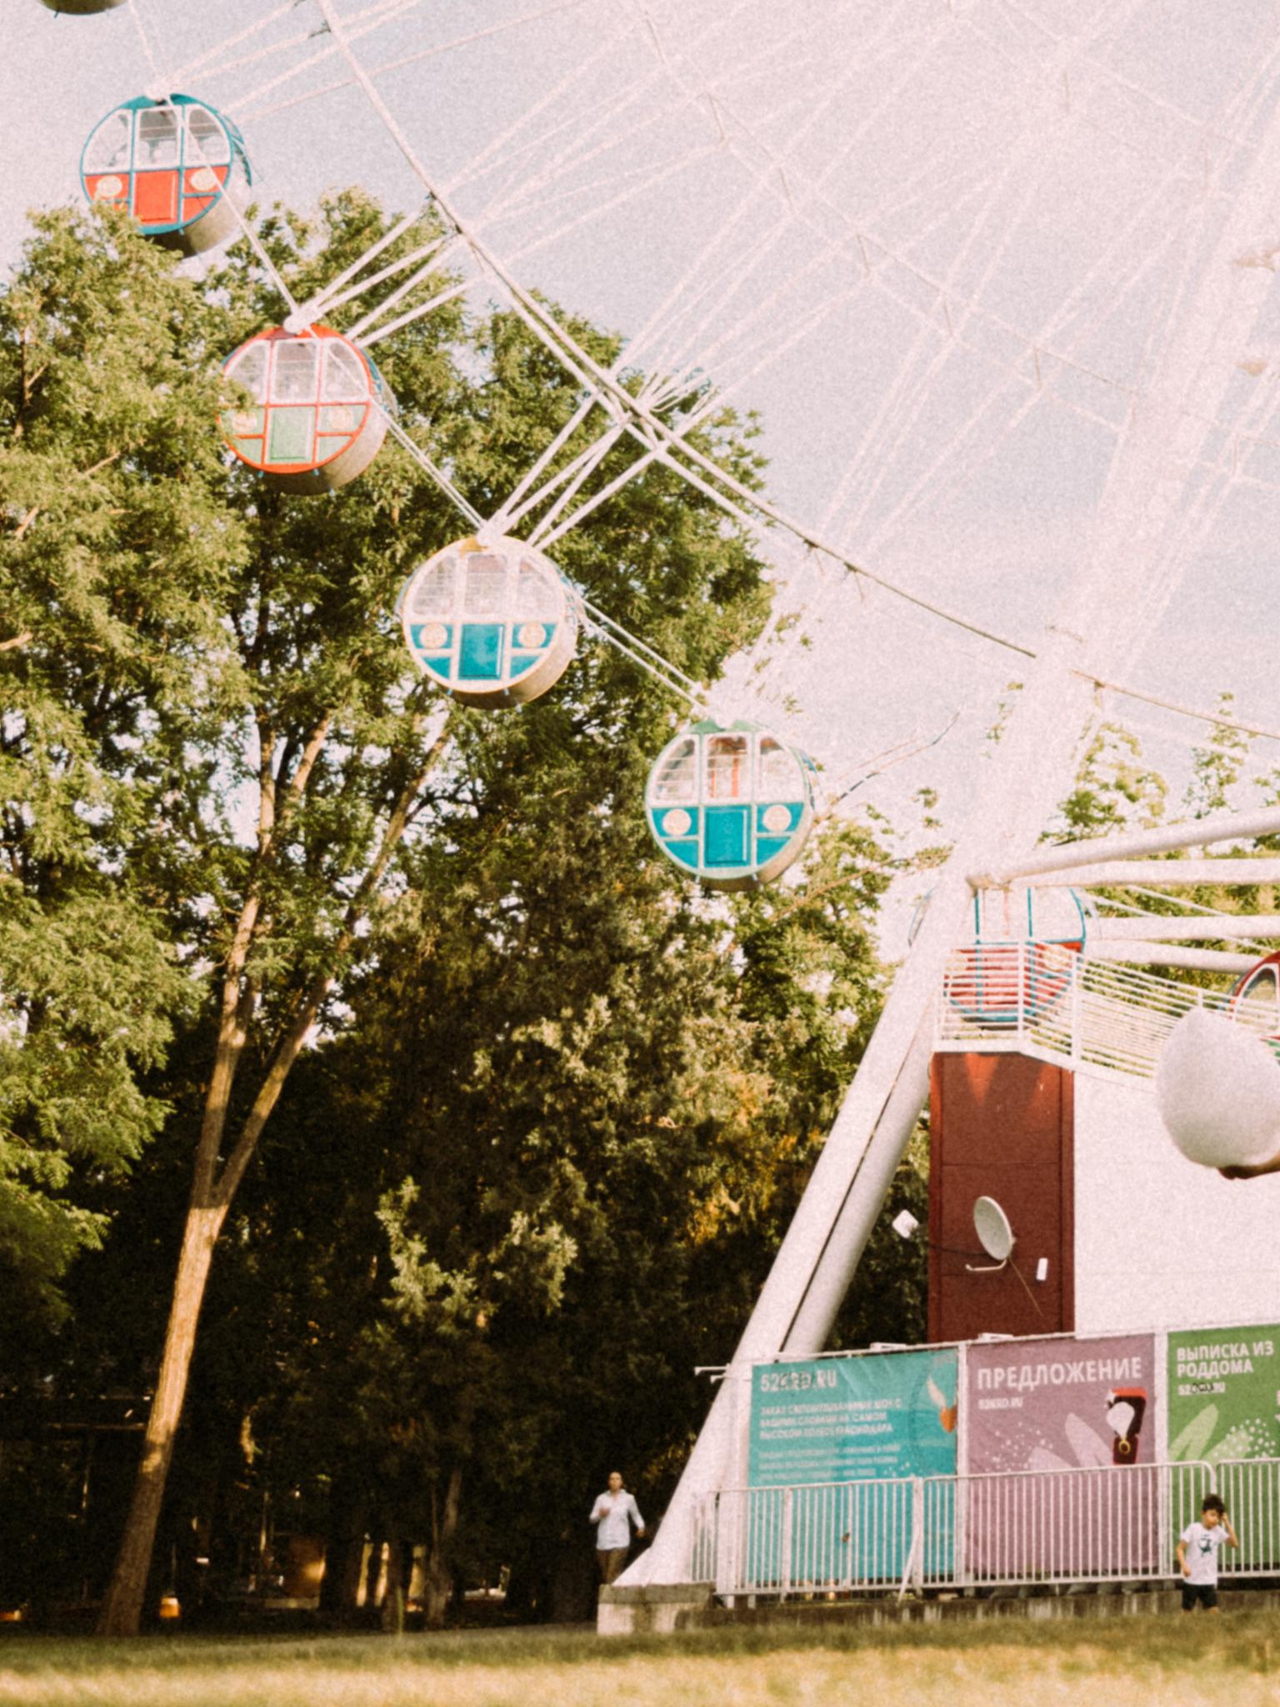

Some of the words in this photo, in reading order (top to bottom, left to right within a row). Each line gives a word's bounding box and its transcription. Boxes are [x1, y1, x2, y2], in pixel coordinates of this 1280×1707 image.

[1177, 1342, 1249, 1361] ВЫПИСКА
[1253, 1340, 1274, 1356] ИЗ
[977, 1356, 1142, 1392] ПРЕДЛОЖЕНИЕ
[1177, 1358, 1254, 1379] РОДДОМА
